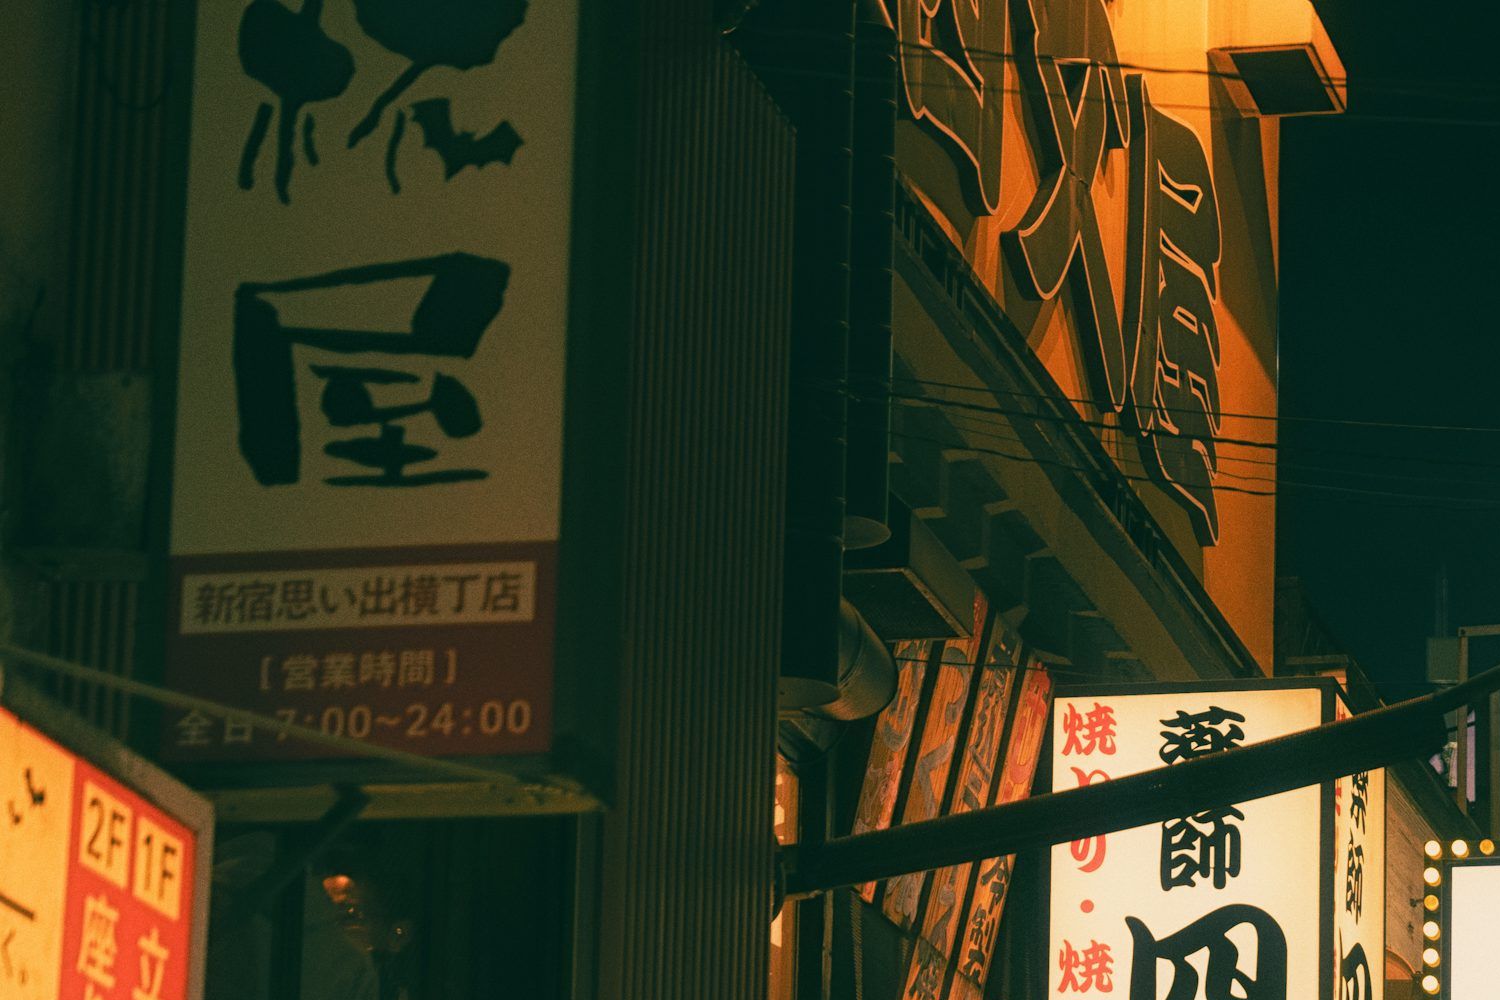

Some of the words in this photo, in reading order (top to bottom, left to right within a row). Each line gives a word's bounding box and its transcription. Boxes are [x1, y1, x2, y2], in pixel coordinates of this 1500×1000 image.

[194, 571, 523, 625] 新宿思い出横丁店
[86, 796, 127, 869] 2F
[142, 832, 179, 902] 1F
